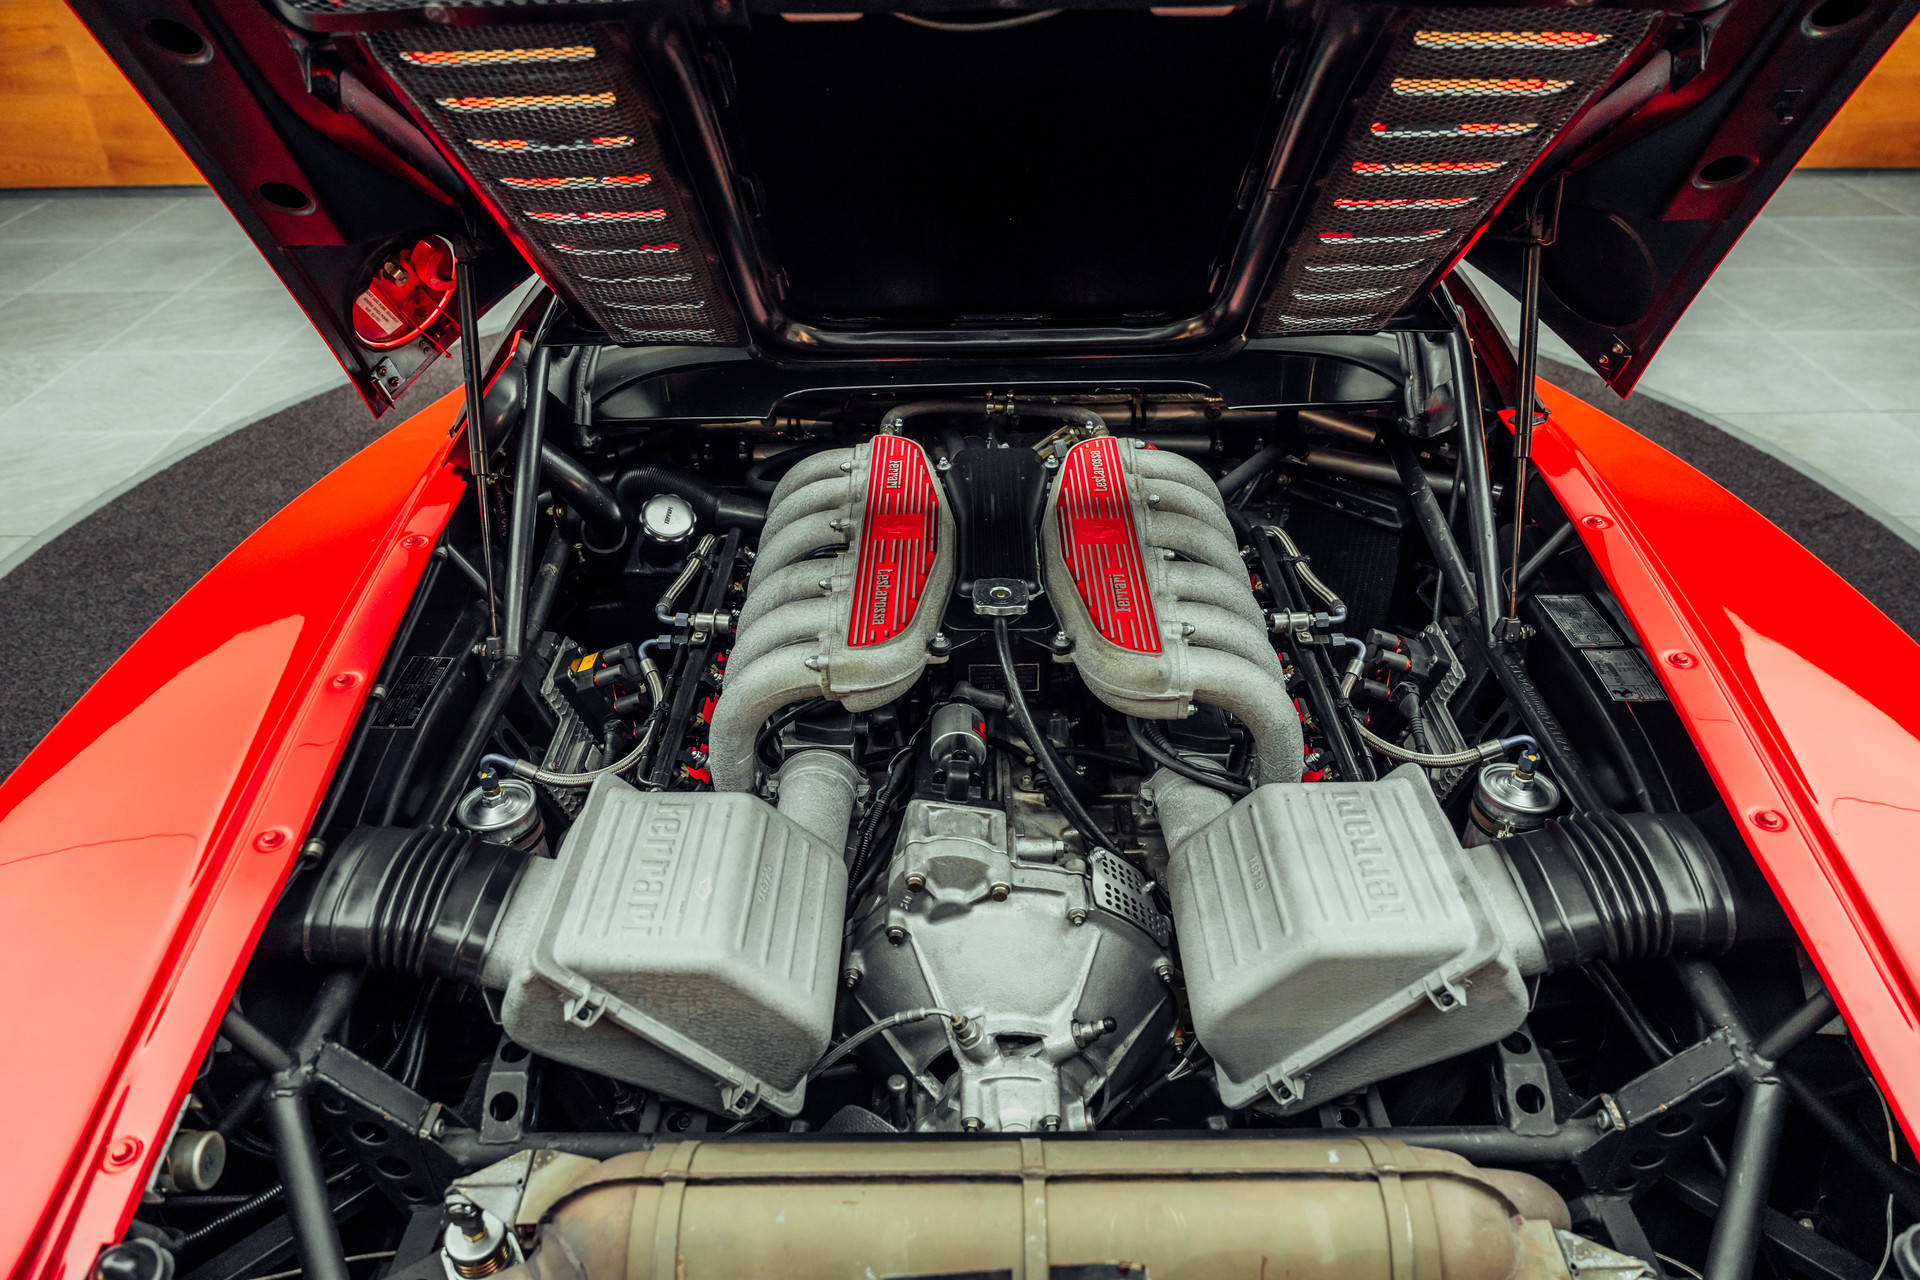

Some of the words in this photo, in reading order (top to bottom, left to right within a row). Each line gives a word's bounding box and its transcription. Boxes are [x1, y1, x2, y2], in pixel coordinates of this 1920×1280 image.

[886, 460, 902, 490] Ferrari
[1089, 450, 1108, 491] testarossa
[872, 568, 894, 626] testarossa
[1109, 573, 1132, 613] Ferrari
[620, 801, 693, 938] Ferrari
[1323, 791, 1408, 922] Ferrari
